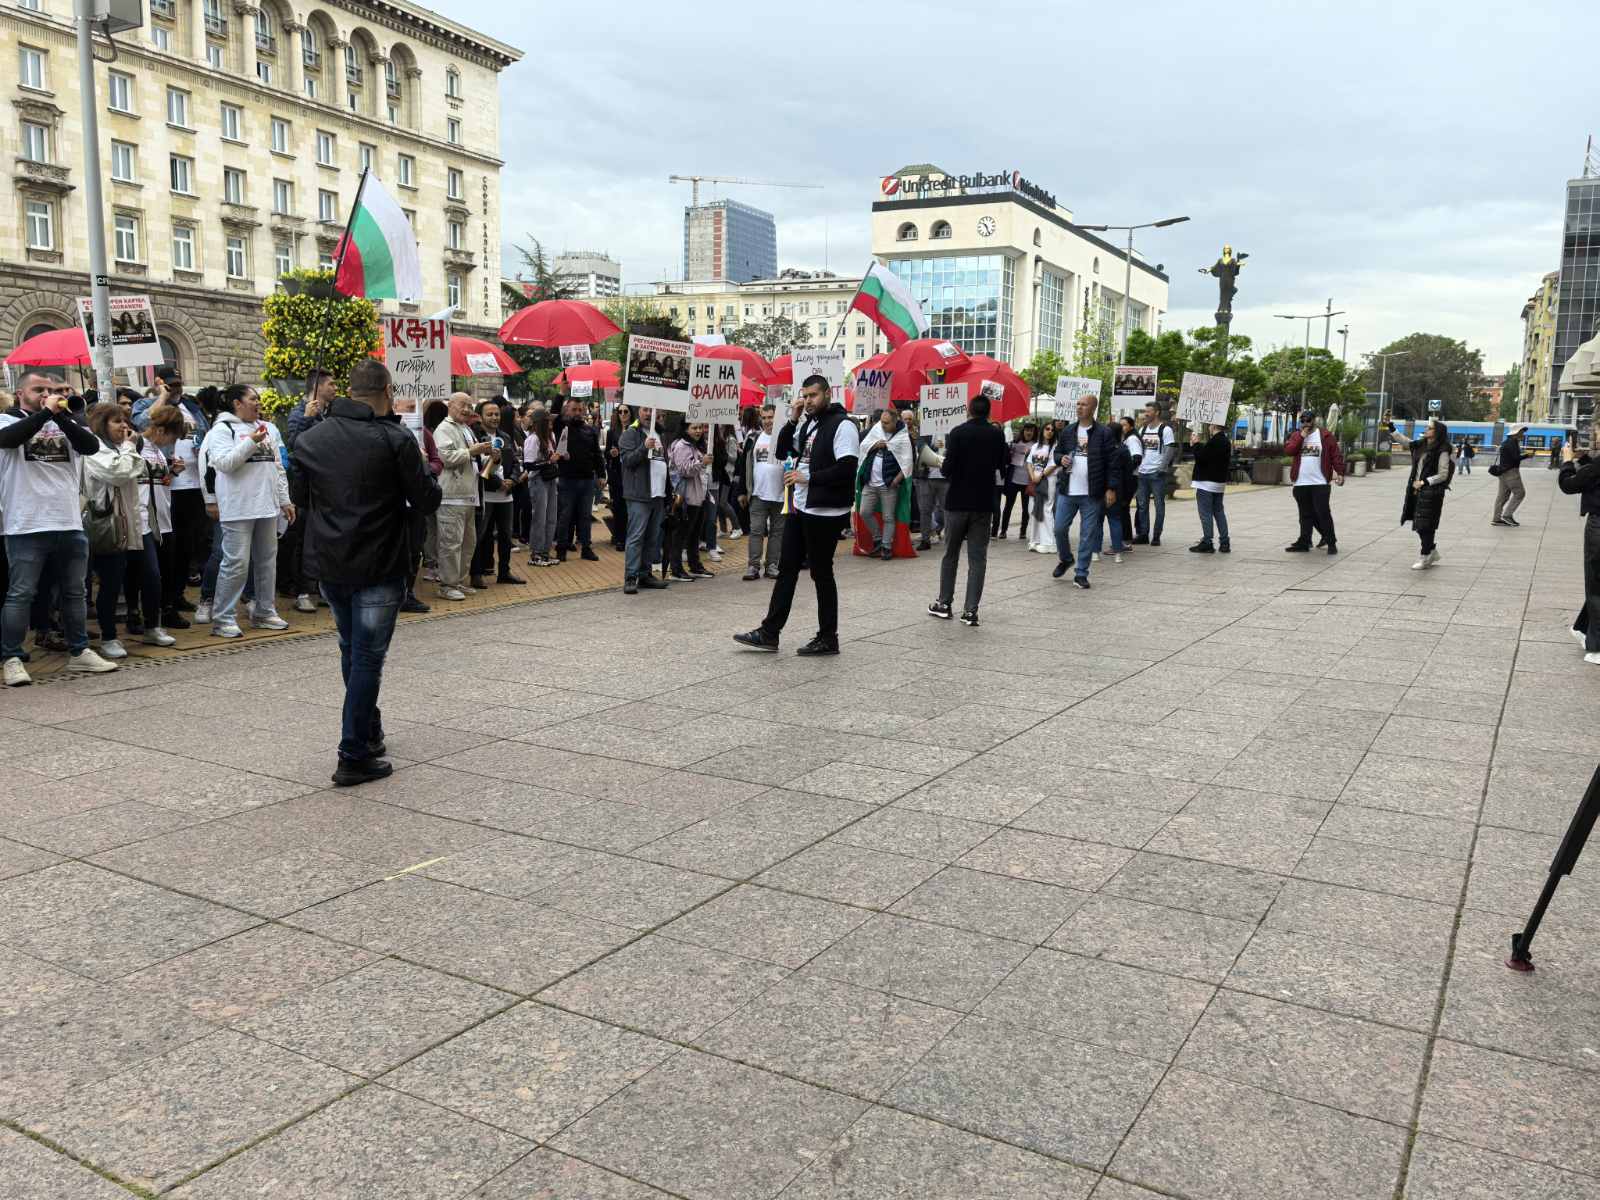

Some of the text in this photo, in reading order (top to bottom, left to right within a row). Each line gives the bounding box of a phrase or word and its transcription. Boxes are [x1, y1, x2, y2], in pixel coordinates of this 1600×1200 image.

[903, 170, 1011, 193] UniCredit Bulbank
[696, 364, 736, 380] НЕ НА
[857, 369, 892, 387] ДОЛУ
[691, 383, 739, 400] ФАЛИТА
[927, 386, 960, 400] НЕ НА
